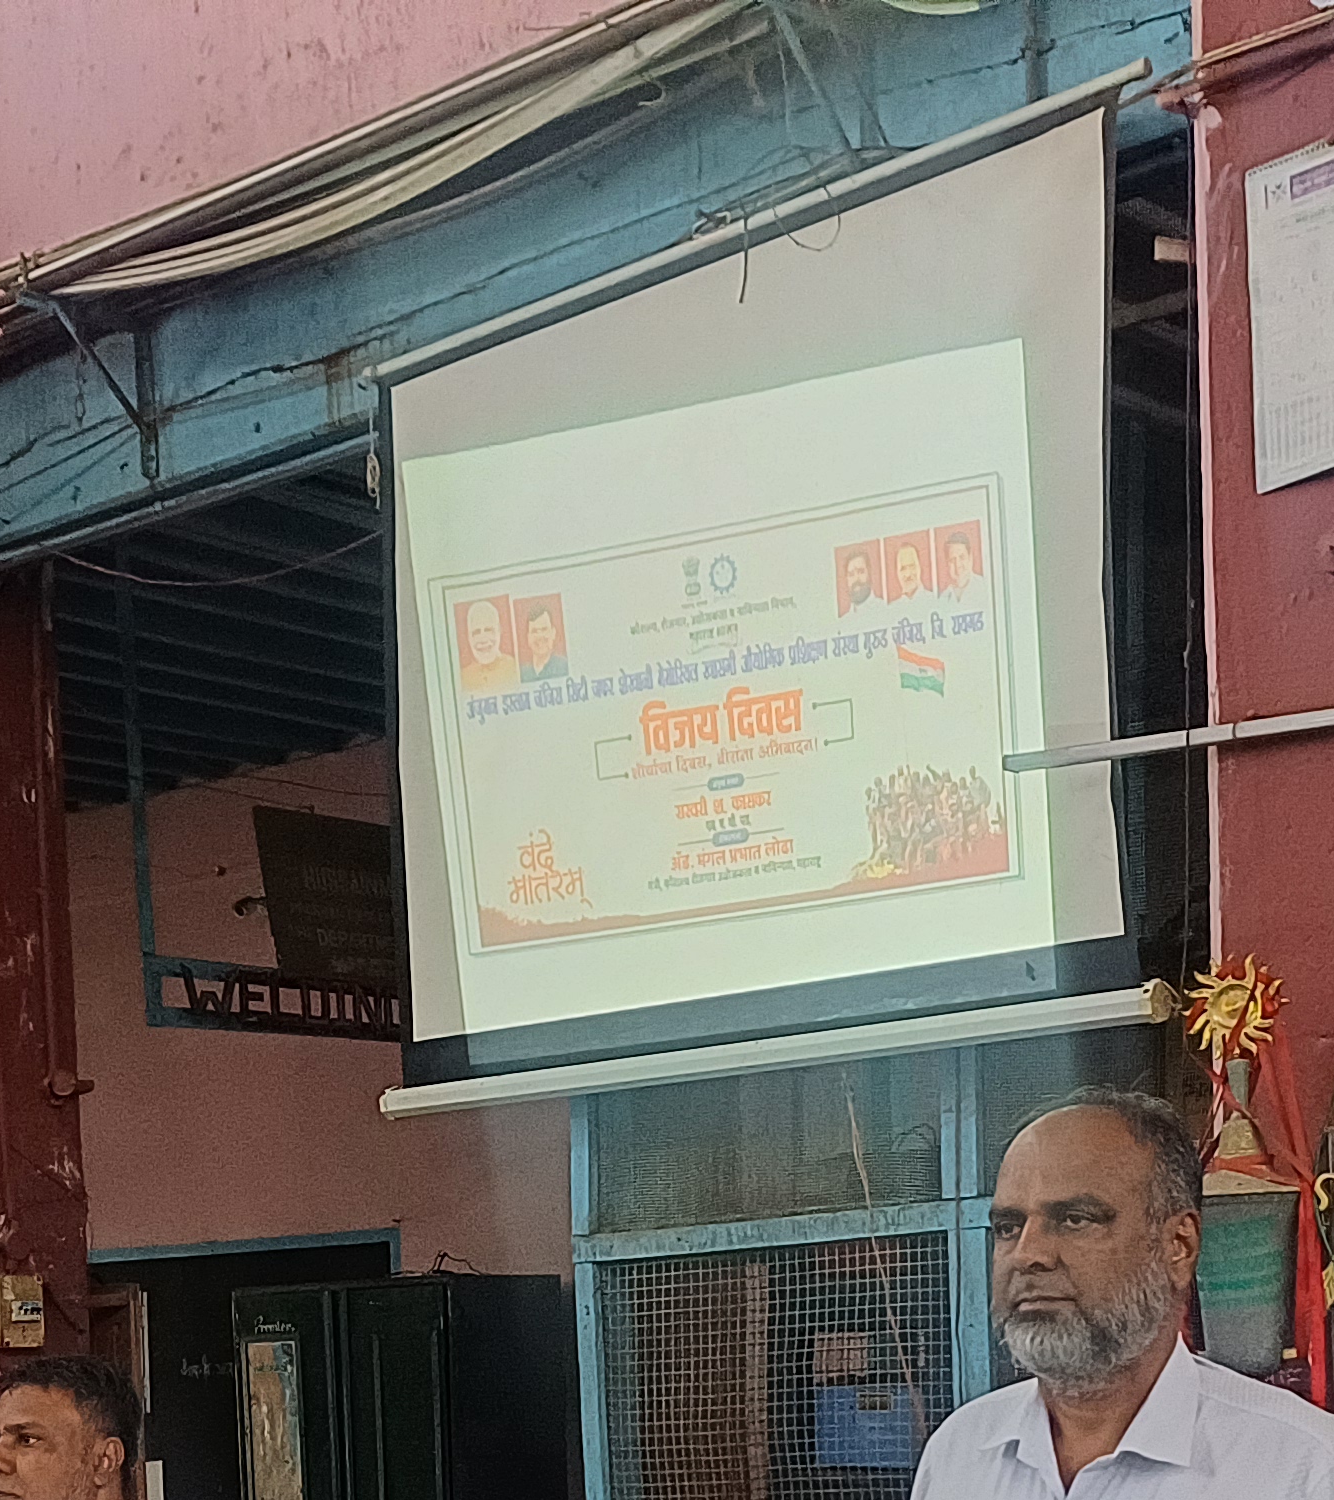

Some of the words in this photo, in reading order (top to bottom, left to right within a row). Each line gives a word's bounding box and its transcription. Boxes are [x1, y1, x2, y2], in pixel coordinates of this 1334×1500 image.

[639, 699, 719, 756] विजय
[723, 686, 803, 742] दिवस
[517, 828, 554, 873] वंदे
[697, 848, 726, 868] मंगल
[729, 844, 762, 863] प्रभात
[508, 866, 593, 909] मातरम्
